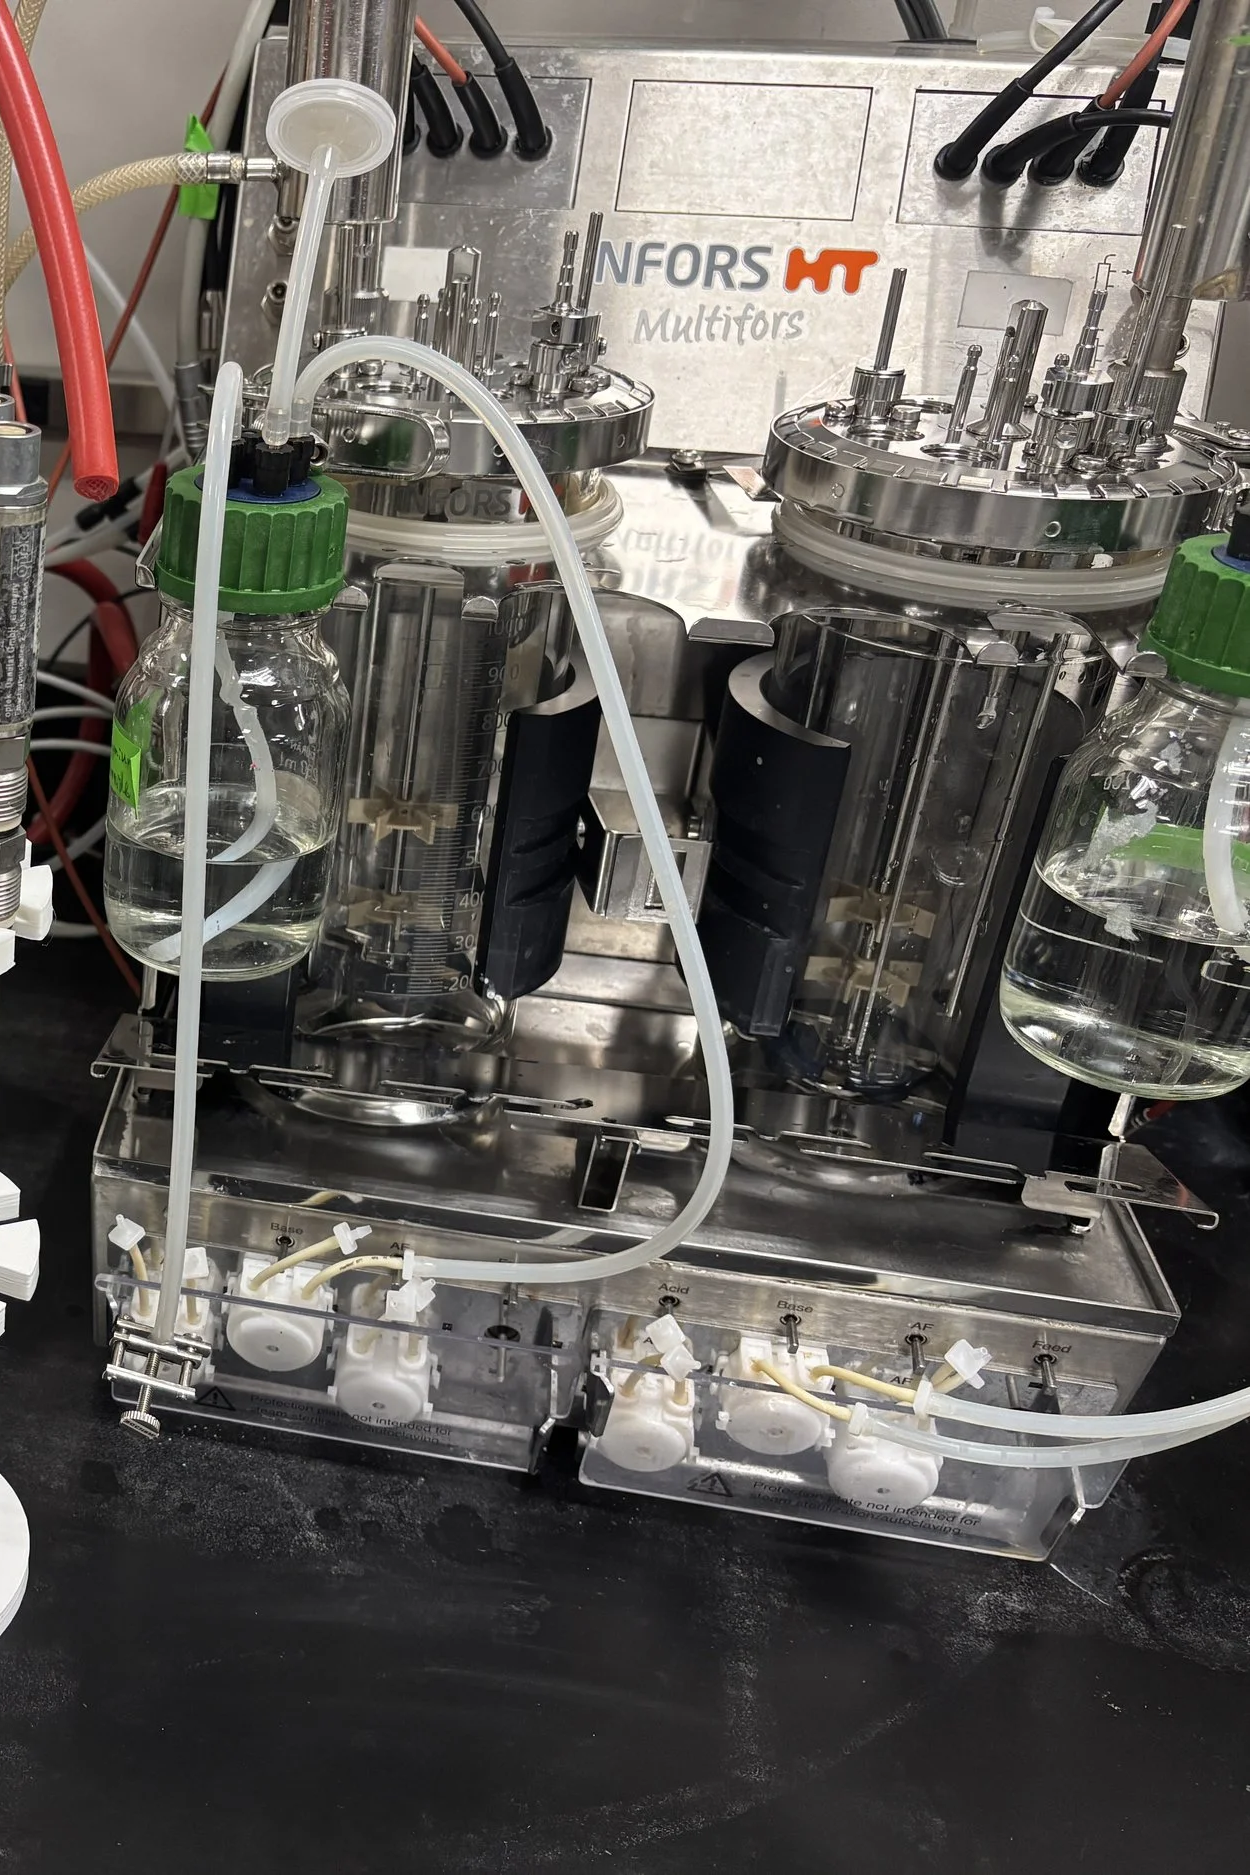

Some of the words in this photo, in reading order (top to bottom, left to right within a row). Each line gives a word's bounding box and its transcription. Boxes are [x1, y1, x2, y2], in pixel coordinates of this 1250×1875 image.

[593, 240, 775, 292] NFORS
[633, 302, 805, 346] Multifors
[453, 933, 475, 951] 30
[270, 1222, 304, 1235] Base
[658, 1282, 690, 1295] Acid
[776, 1300, 814, 1314] Base
[910, 1321, 935, 1332] AF
[1032, 1340, 1072, 1354] Feed
[890, 1375, 913, 1385] AF
[351, 1413, 373, 1424] not
[375, 1416, 434, 1433] intended
[753, 1480, 824, 1499] Protection
[866, 1500, 891, 1513] not
[893, 1504, 957, 1524] intended
[958, 1515, 981, 1528] for
